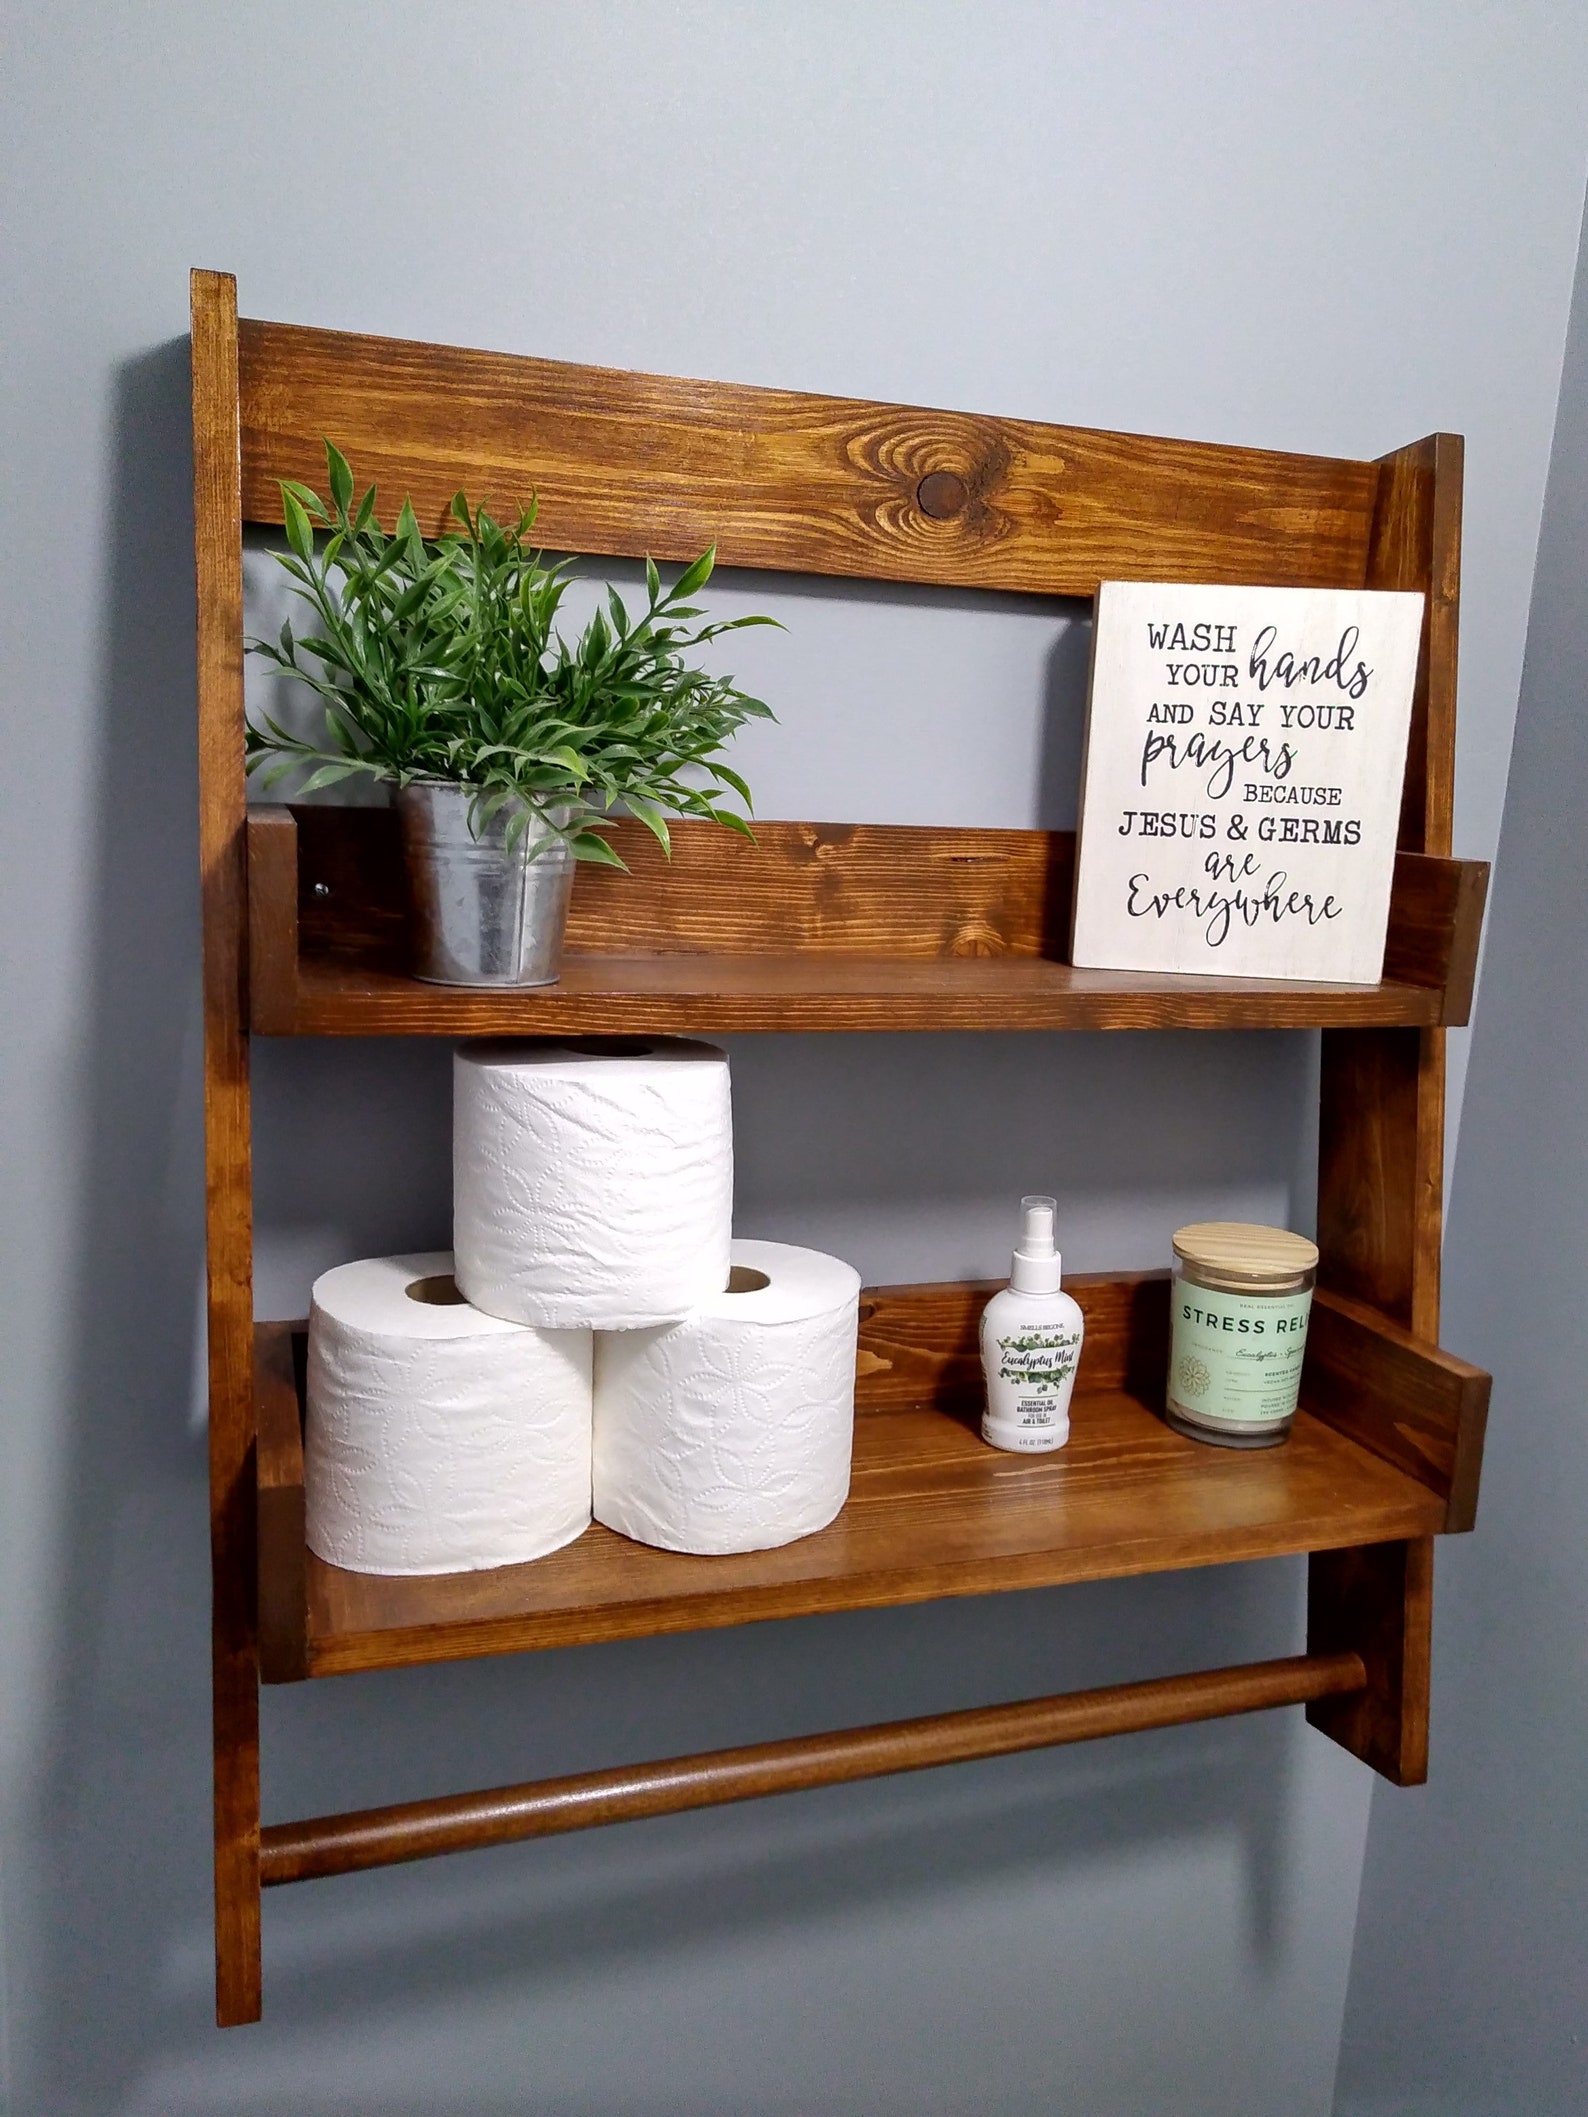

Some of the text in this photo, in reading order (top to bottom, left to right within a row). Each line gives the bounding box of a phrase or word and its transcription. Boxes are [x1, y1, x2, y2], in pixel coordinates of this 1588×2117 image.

[1147, 623, 1238, 653] WASH
[1166, 625, 1374, 699] YOUR hands
[1146, 701, 1355, 730] AND SAY YOUR
[1141, 730, 1298, 799] prayers
[1243, 784, 1342, 806] BECAUSE
[1118, 811, 1361, 845] JESUS & GERMS
[1204, 851, 1261, 883] are
[1127, 871, 1342, 947] Everywhere
[1182, 1305, 1265, 1334] STRESS
[1001, 1349, 1074, 1370] Eucalyptus Mint
